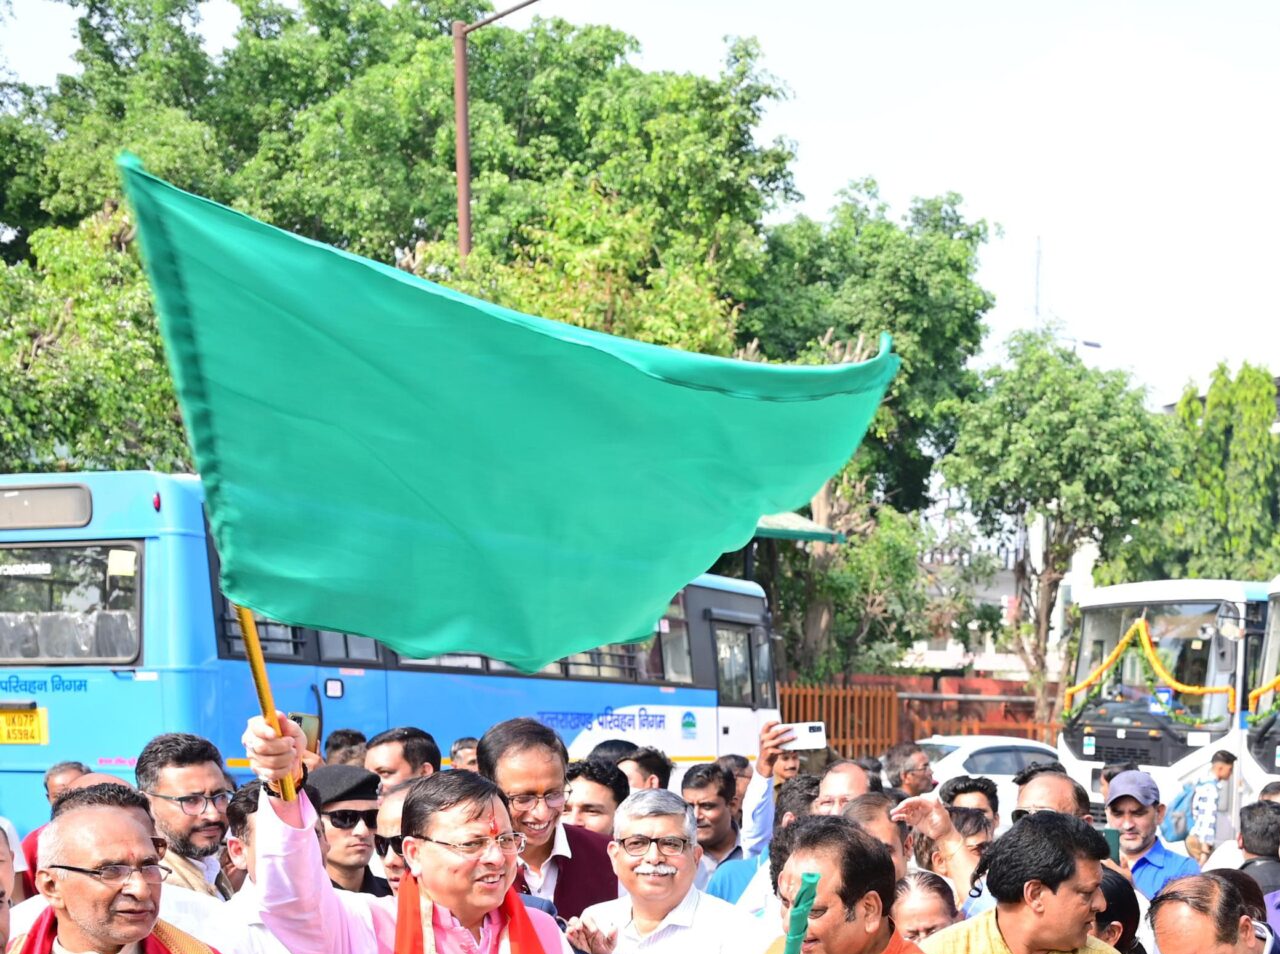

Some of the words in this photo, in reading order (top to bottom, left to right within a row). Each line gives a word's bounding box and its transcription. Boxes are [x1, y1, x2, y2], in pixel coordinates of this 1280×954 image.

[0, 675, 47, 693] परिवहन
[51, 675, 88, 692] निगम
[597, 705, 635, 732] परिवहन
[638, 707, 666, 730] निगम
